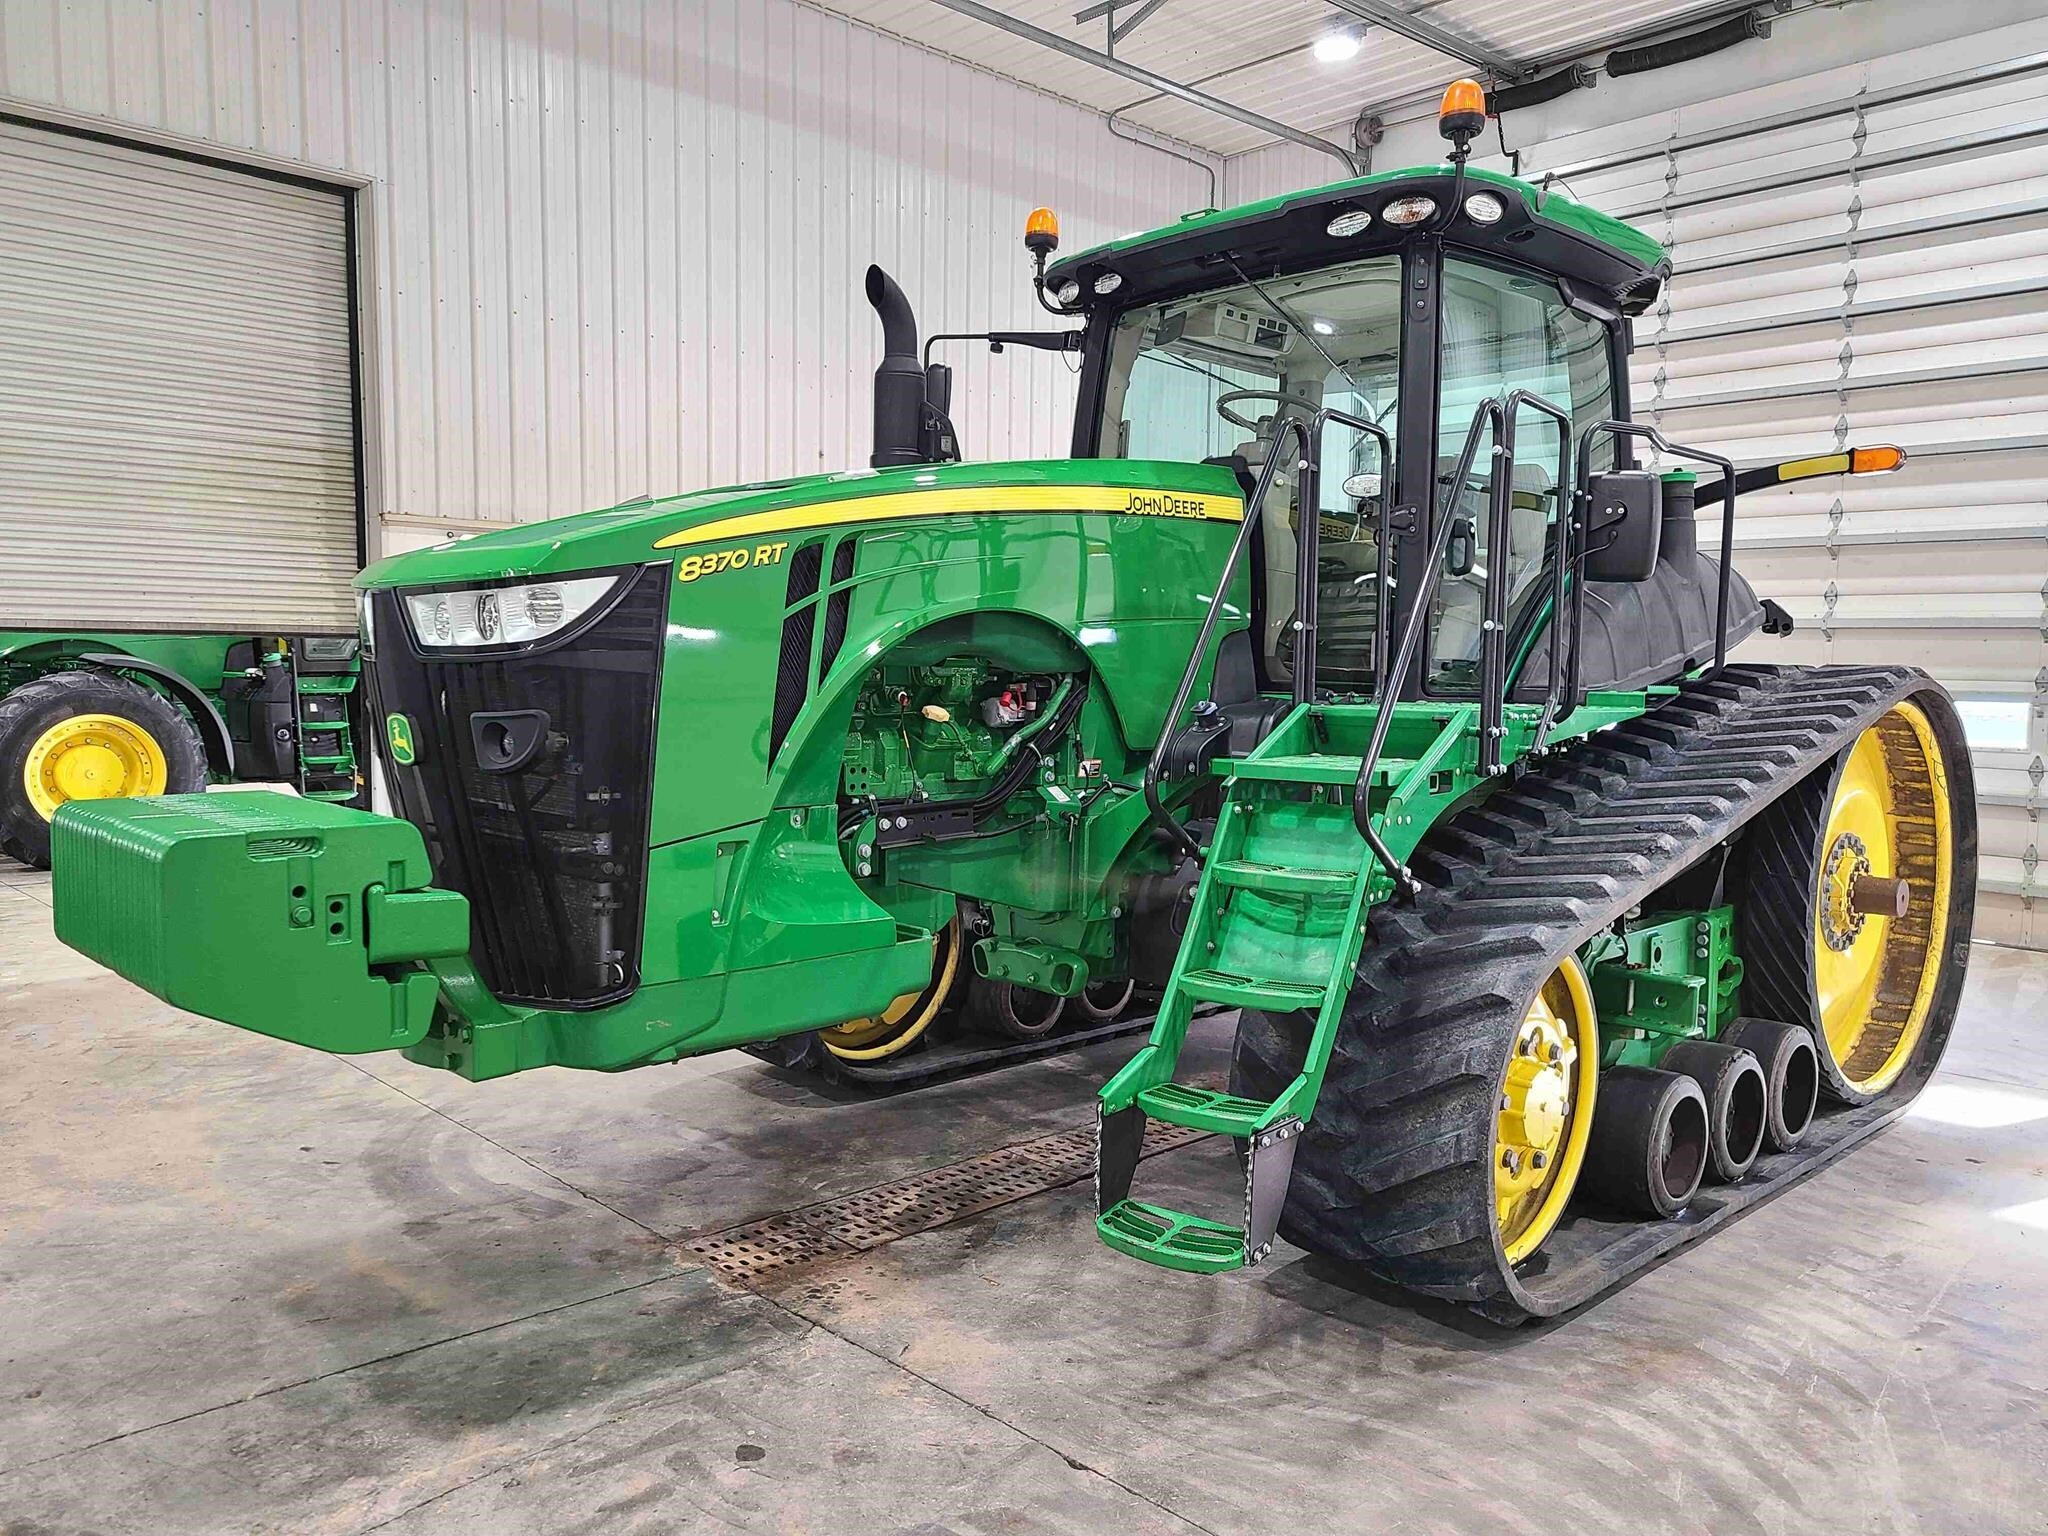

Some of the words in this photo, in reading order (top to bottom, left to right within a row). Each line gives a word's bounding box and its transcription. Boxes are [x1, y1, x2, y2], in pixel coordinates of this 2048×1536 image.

[1125, 492, 1162, 513] JOHN
[1163, 495, 1206, 516] DEERE
[678, 548, 751, 583] 8370
[753, 541, 789, 568] RT
